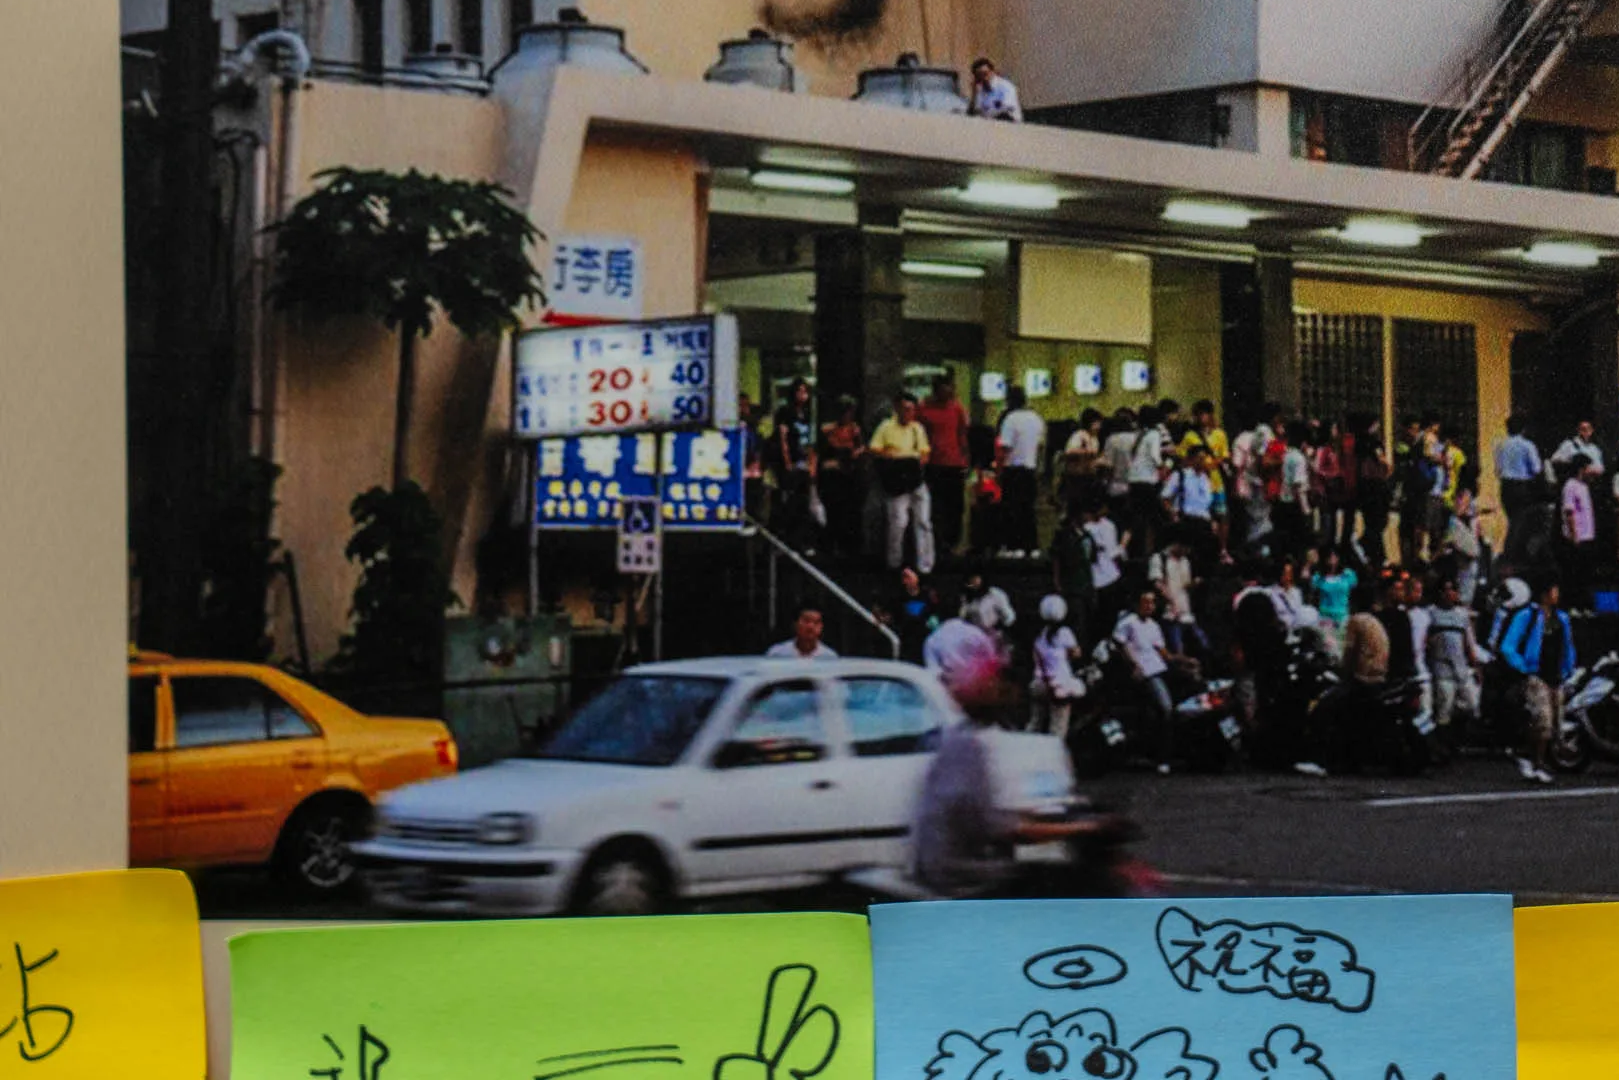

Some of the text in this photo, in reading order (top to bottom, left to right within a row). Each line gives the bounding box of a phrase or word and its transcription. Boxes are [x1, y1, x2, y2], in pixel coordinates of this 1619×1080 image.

[588, 367, 633, 394] 20
[669, 361, 705, 386] 40
[587, 400, 633, 427] 30
[671, 394, 705, 421] 50
